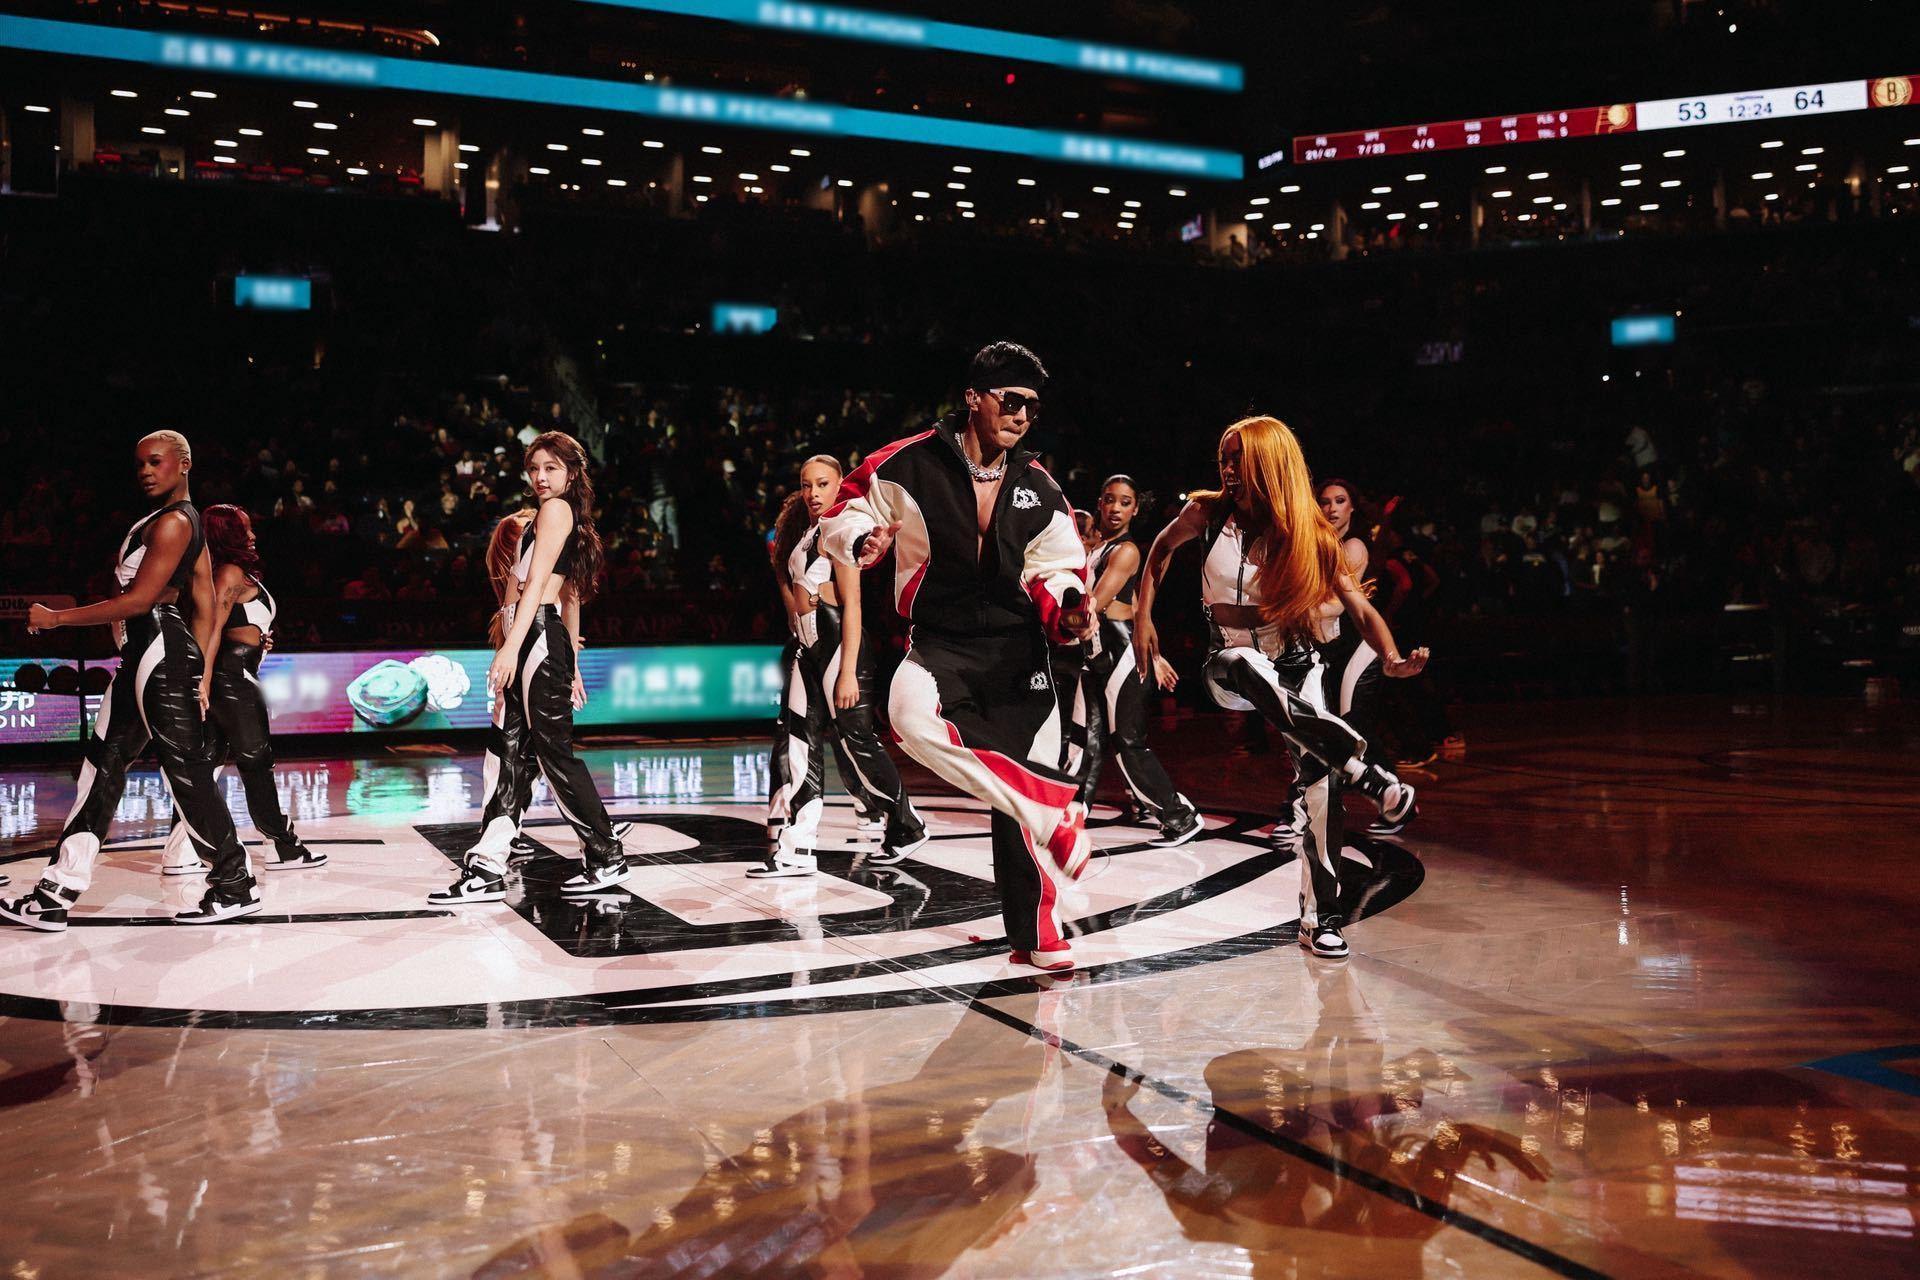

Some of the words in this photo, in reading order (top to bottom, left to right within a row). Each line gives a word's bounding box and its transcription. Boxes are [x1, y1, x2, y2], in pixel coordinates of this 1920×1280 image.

[1794, 90, 1824, 110] 64
[1886, 82, 1897, 102] B
[1678, 102, 1707, 122] 53
[1727, 102, 1772, 119] 12:24
